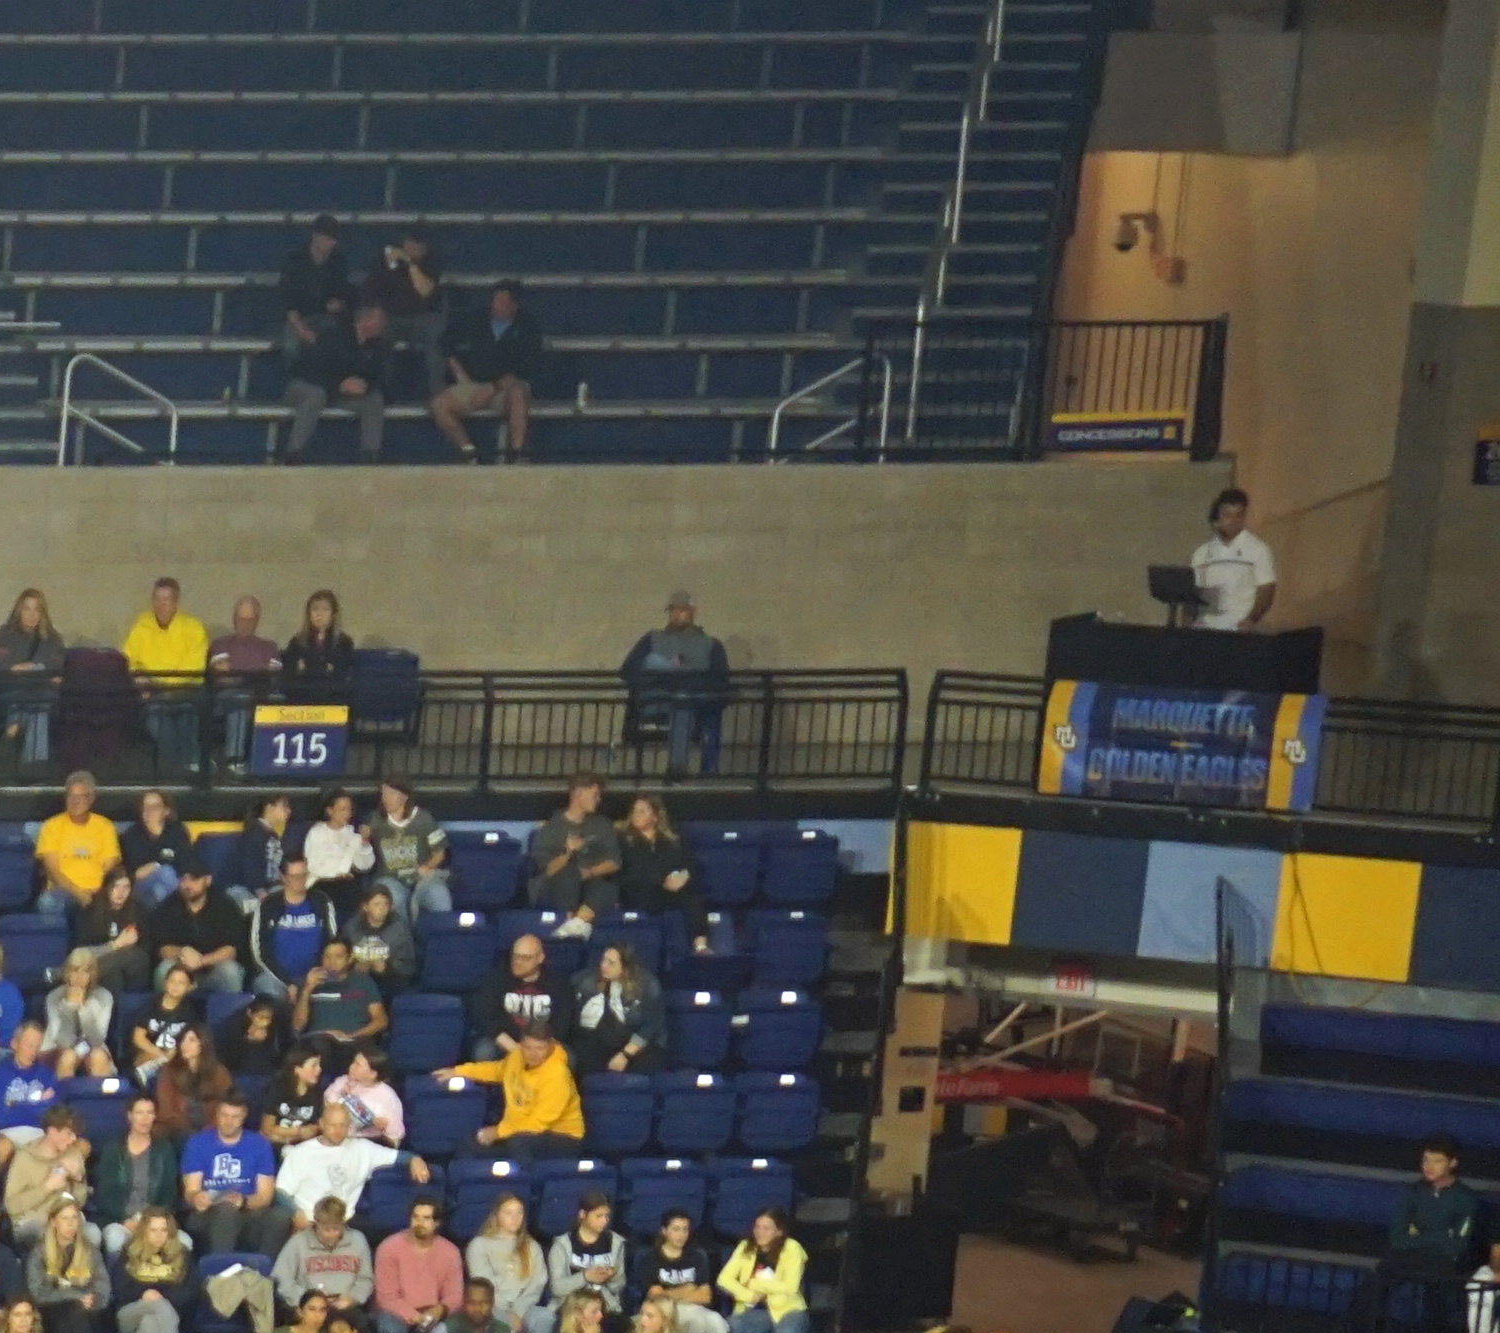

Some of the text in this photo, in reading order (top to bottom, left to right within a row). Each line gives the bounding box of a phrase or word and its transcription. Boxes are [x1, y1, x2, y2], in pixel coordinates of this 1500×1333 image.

[1112, 698, 1255, 736] MARQUETTE
[273, 732, 327, 765] 115
[1086, 748, 1268, 788] GOLDEN EAGLES
[306, 1254, 360, 1273] WISCONSIN
